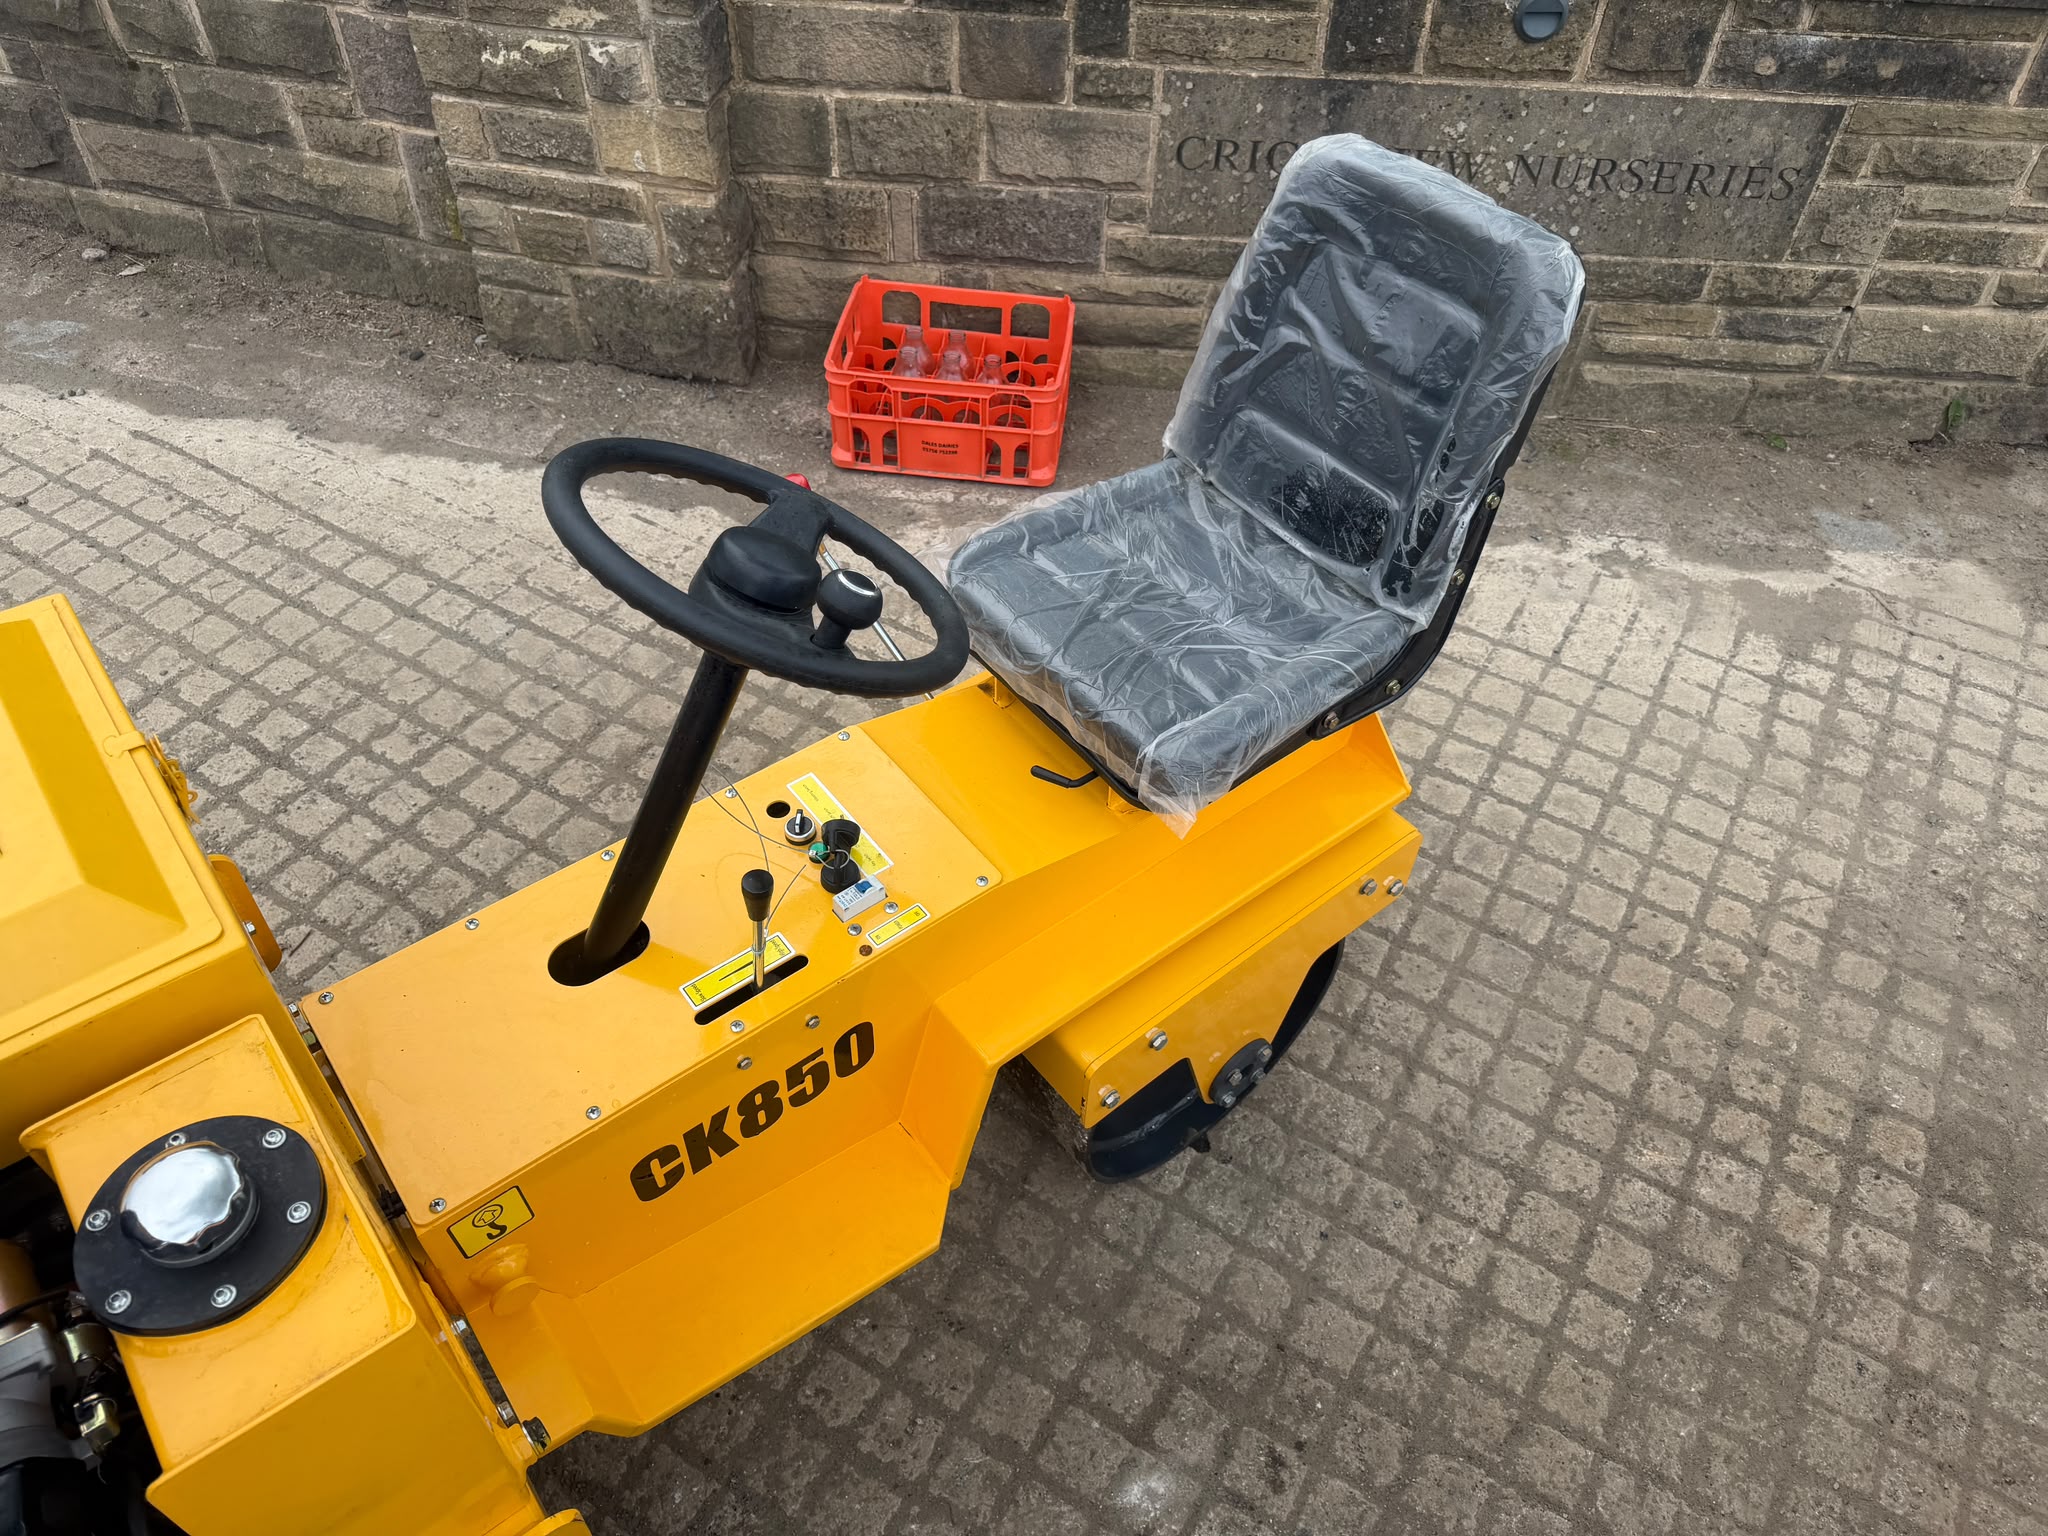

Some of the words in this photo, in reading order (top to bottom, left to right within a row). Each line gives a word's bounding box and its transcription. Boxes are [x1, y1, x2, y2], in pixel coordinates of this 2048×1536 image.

[1176, 136, 1300, 174] CRIC
[1509, 153, 1802, 201] NURSERIES
[921, 440, 938, 448] DALES
[630, 1021, 875, 1202] CK850
